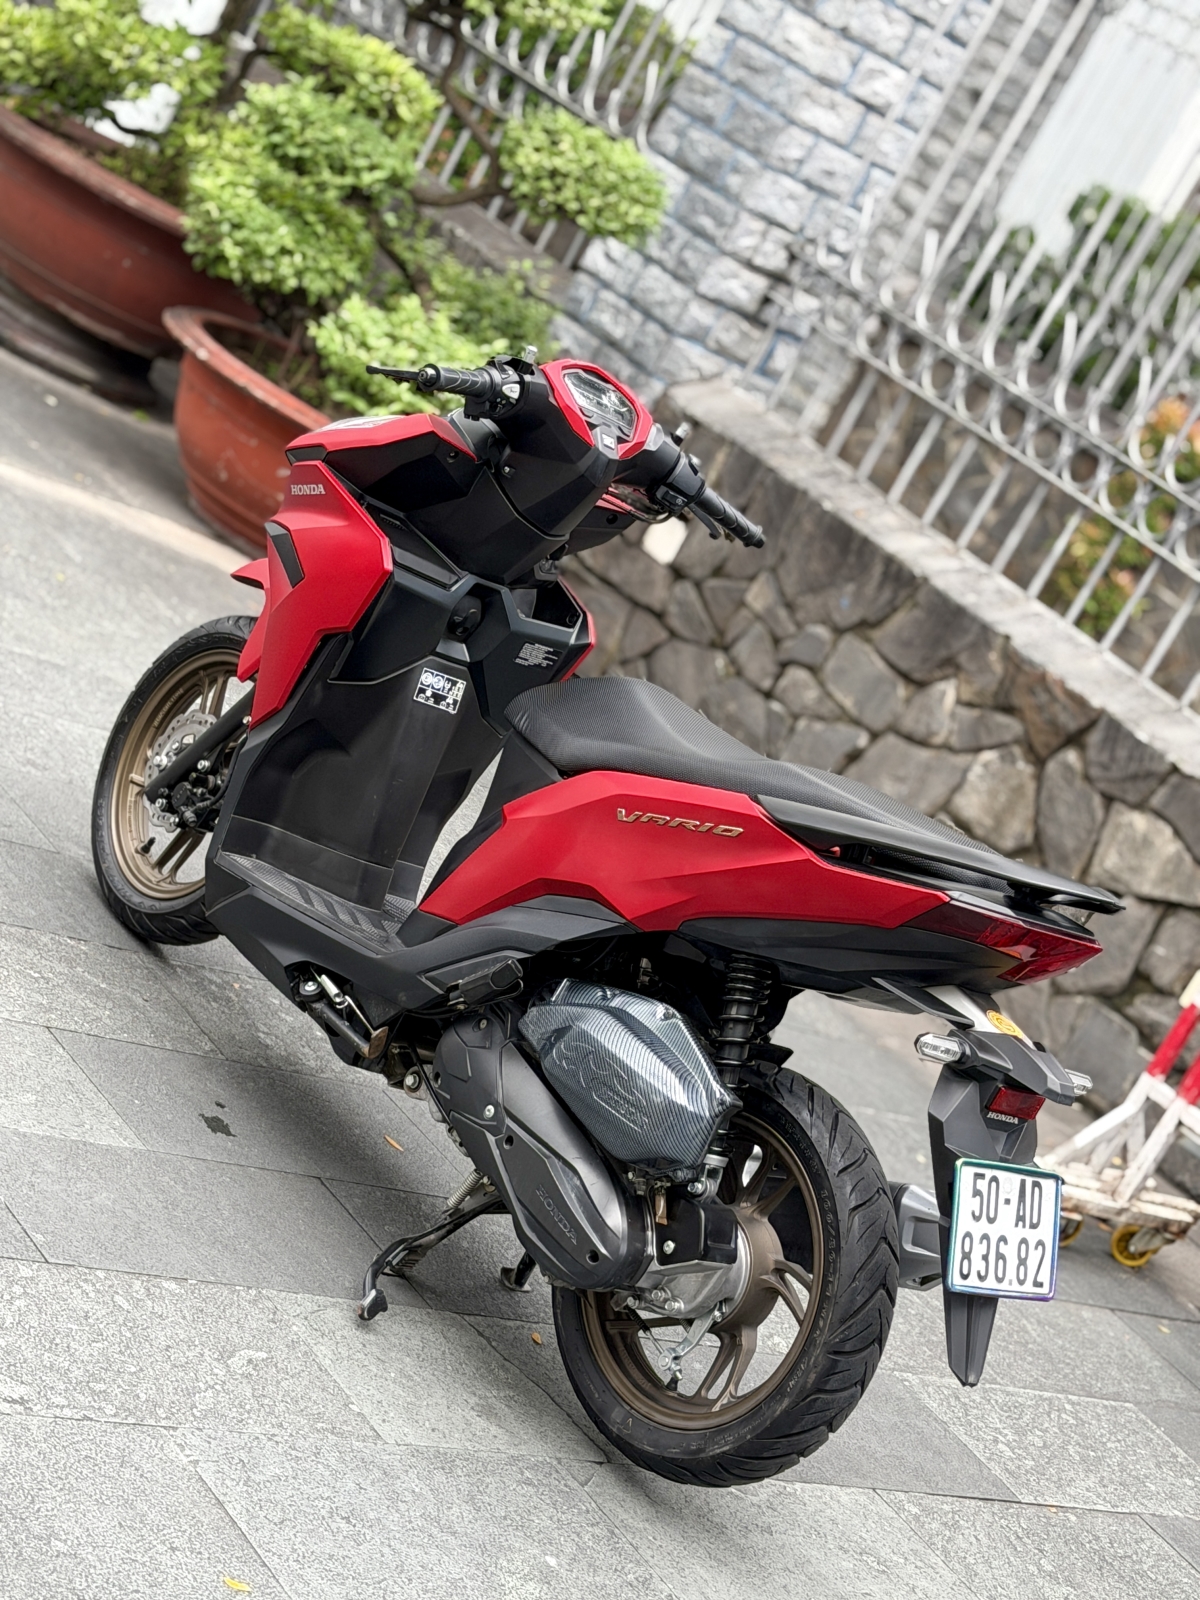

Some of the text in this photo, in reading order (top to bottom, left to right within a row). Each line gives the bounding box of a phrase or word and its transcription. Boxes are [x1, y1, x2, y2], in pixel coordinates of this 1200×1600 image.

[290, 484, 326, 495] HONDA
[617, 808, 744, 837] VARIO
[986, 1111, 1019, 1125] HONDA
[535, 1185, 578, 1246] HONDA
[971, 1172, 1043, 1230] 50-AD
[959, 1230, 1046, 1289] 836.82
